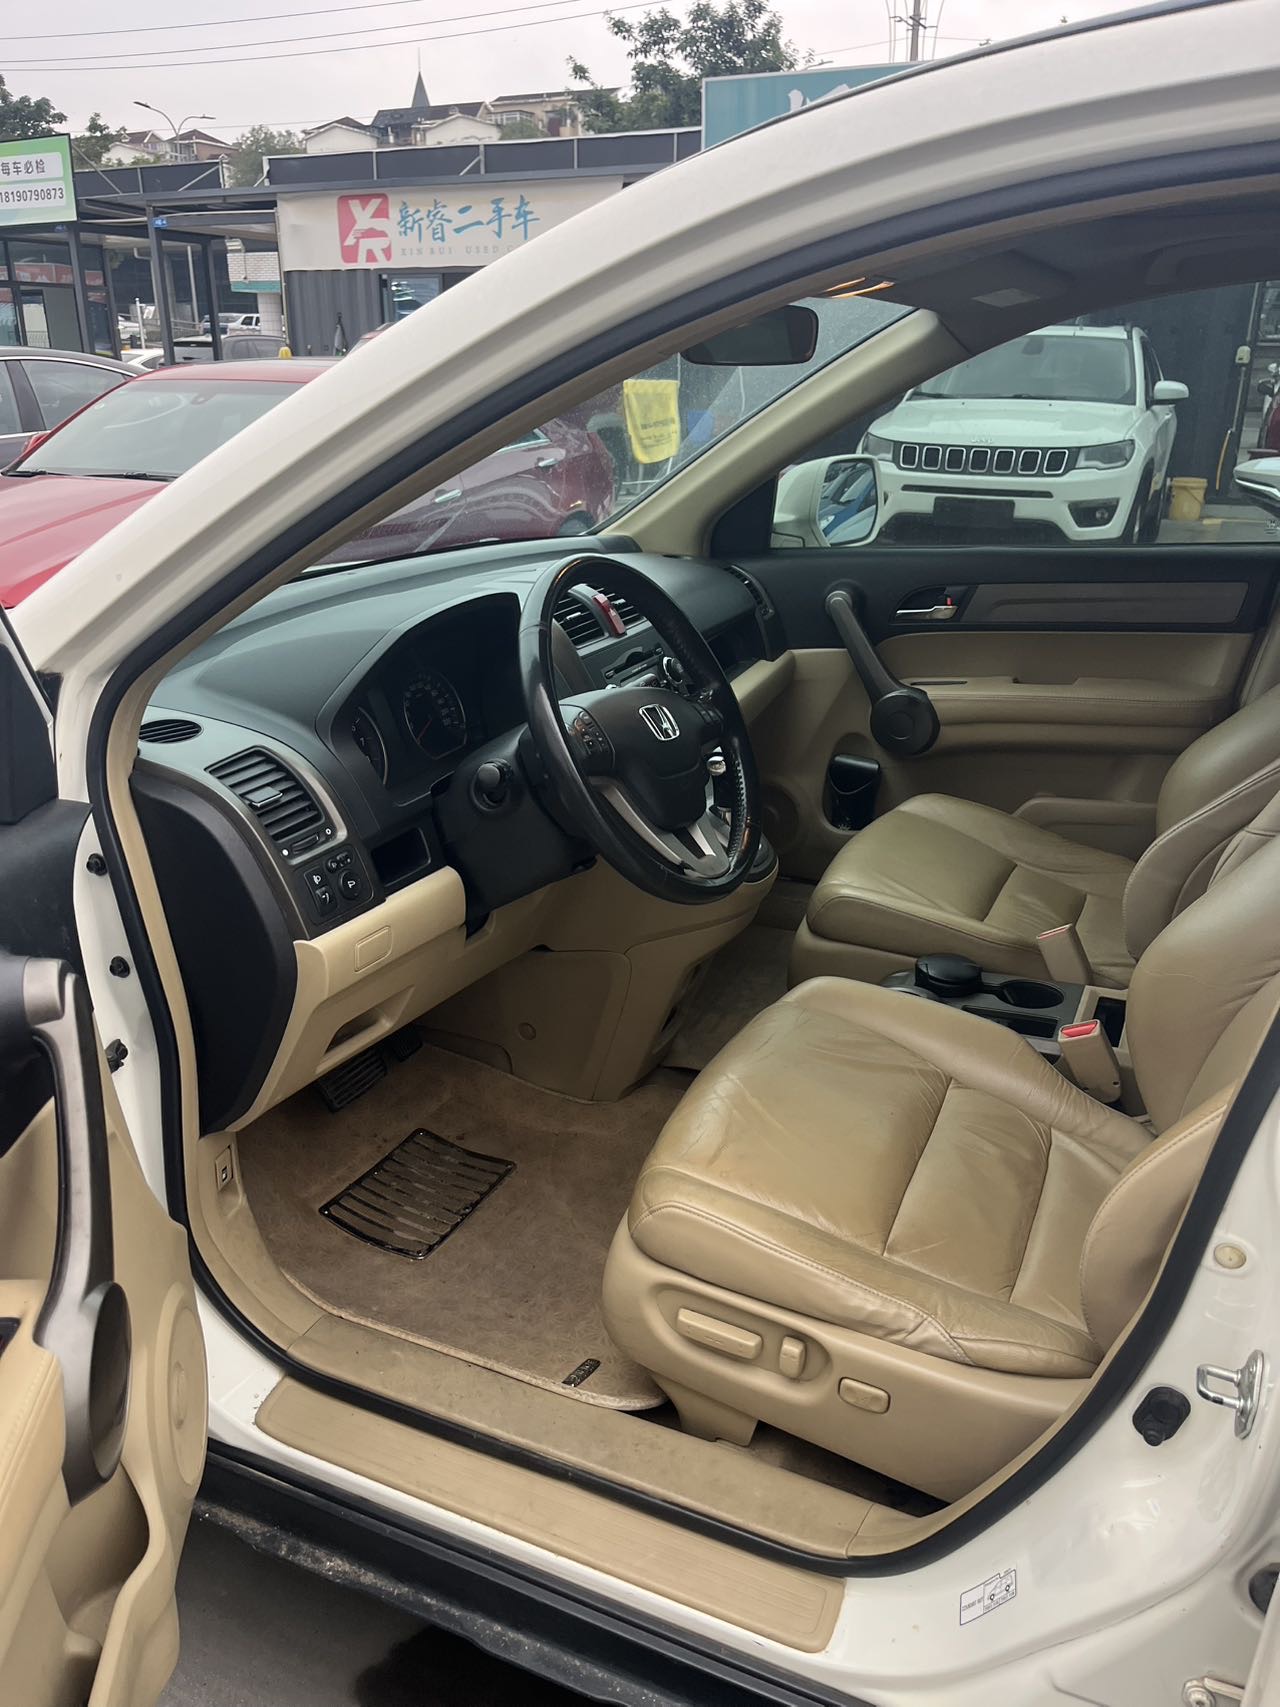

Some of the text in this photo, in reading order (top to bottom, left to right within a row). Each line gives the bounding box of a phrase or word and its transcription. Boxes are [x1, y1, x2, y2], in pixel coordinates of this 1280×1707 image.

[1, 159, 46, 177] 每车必检
[0, 187, 64, 203] 18190790873
[397, 194, 540, 243] 新睿二手车
[400, 247, 424, 256] XIN
[465, 245, 500, 254] USED
